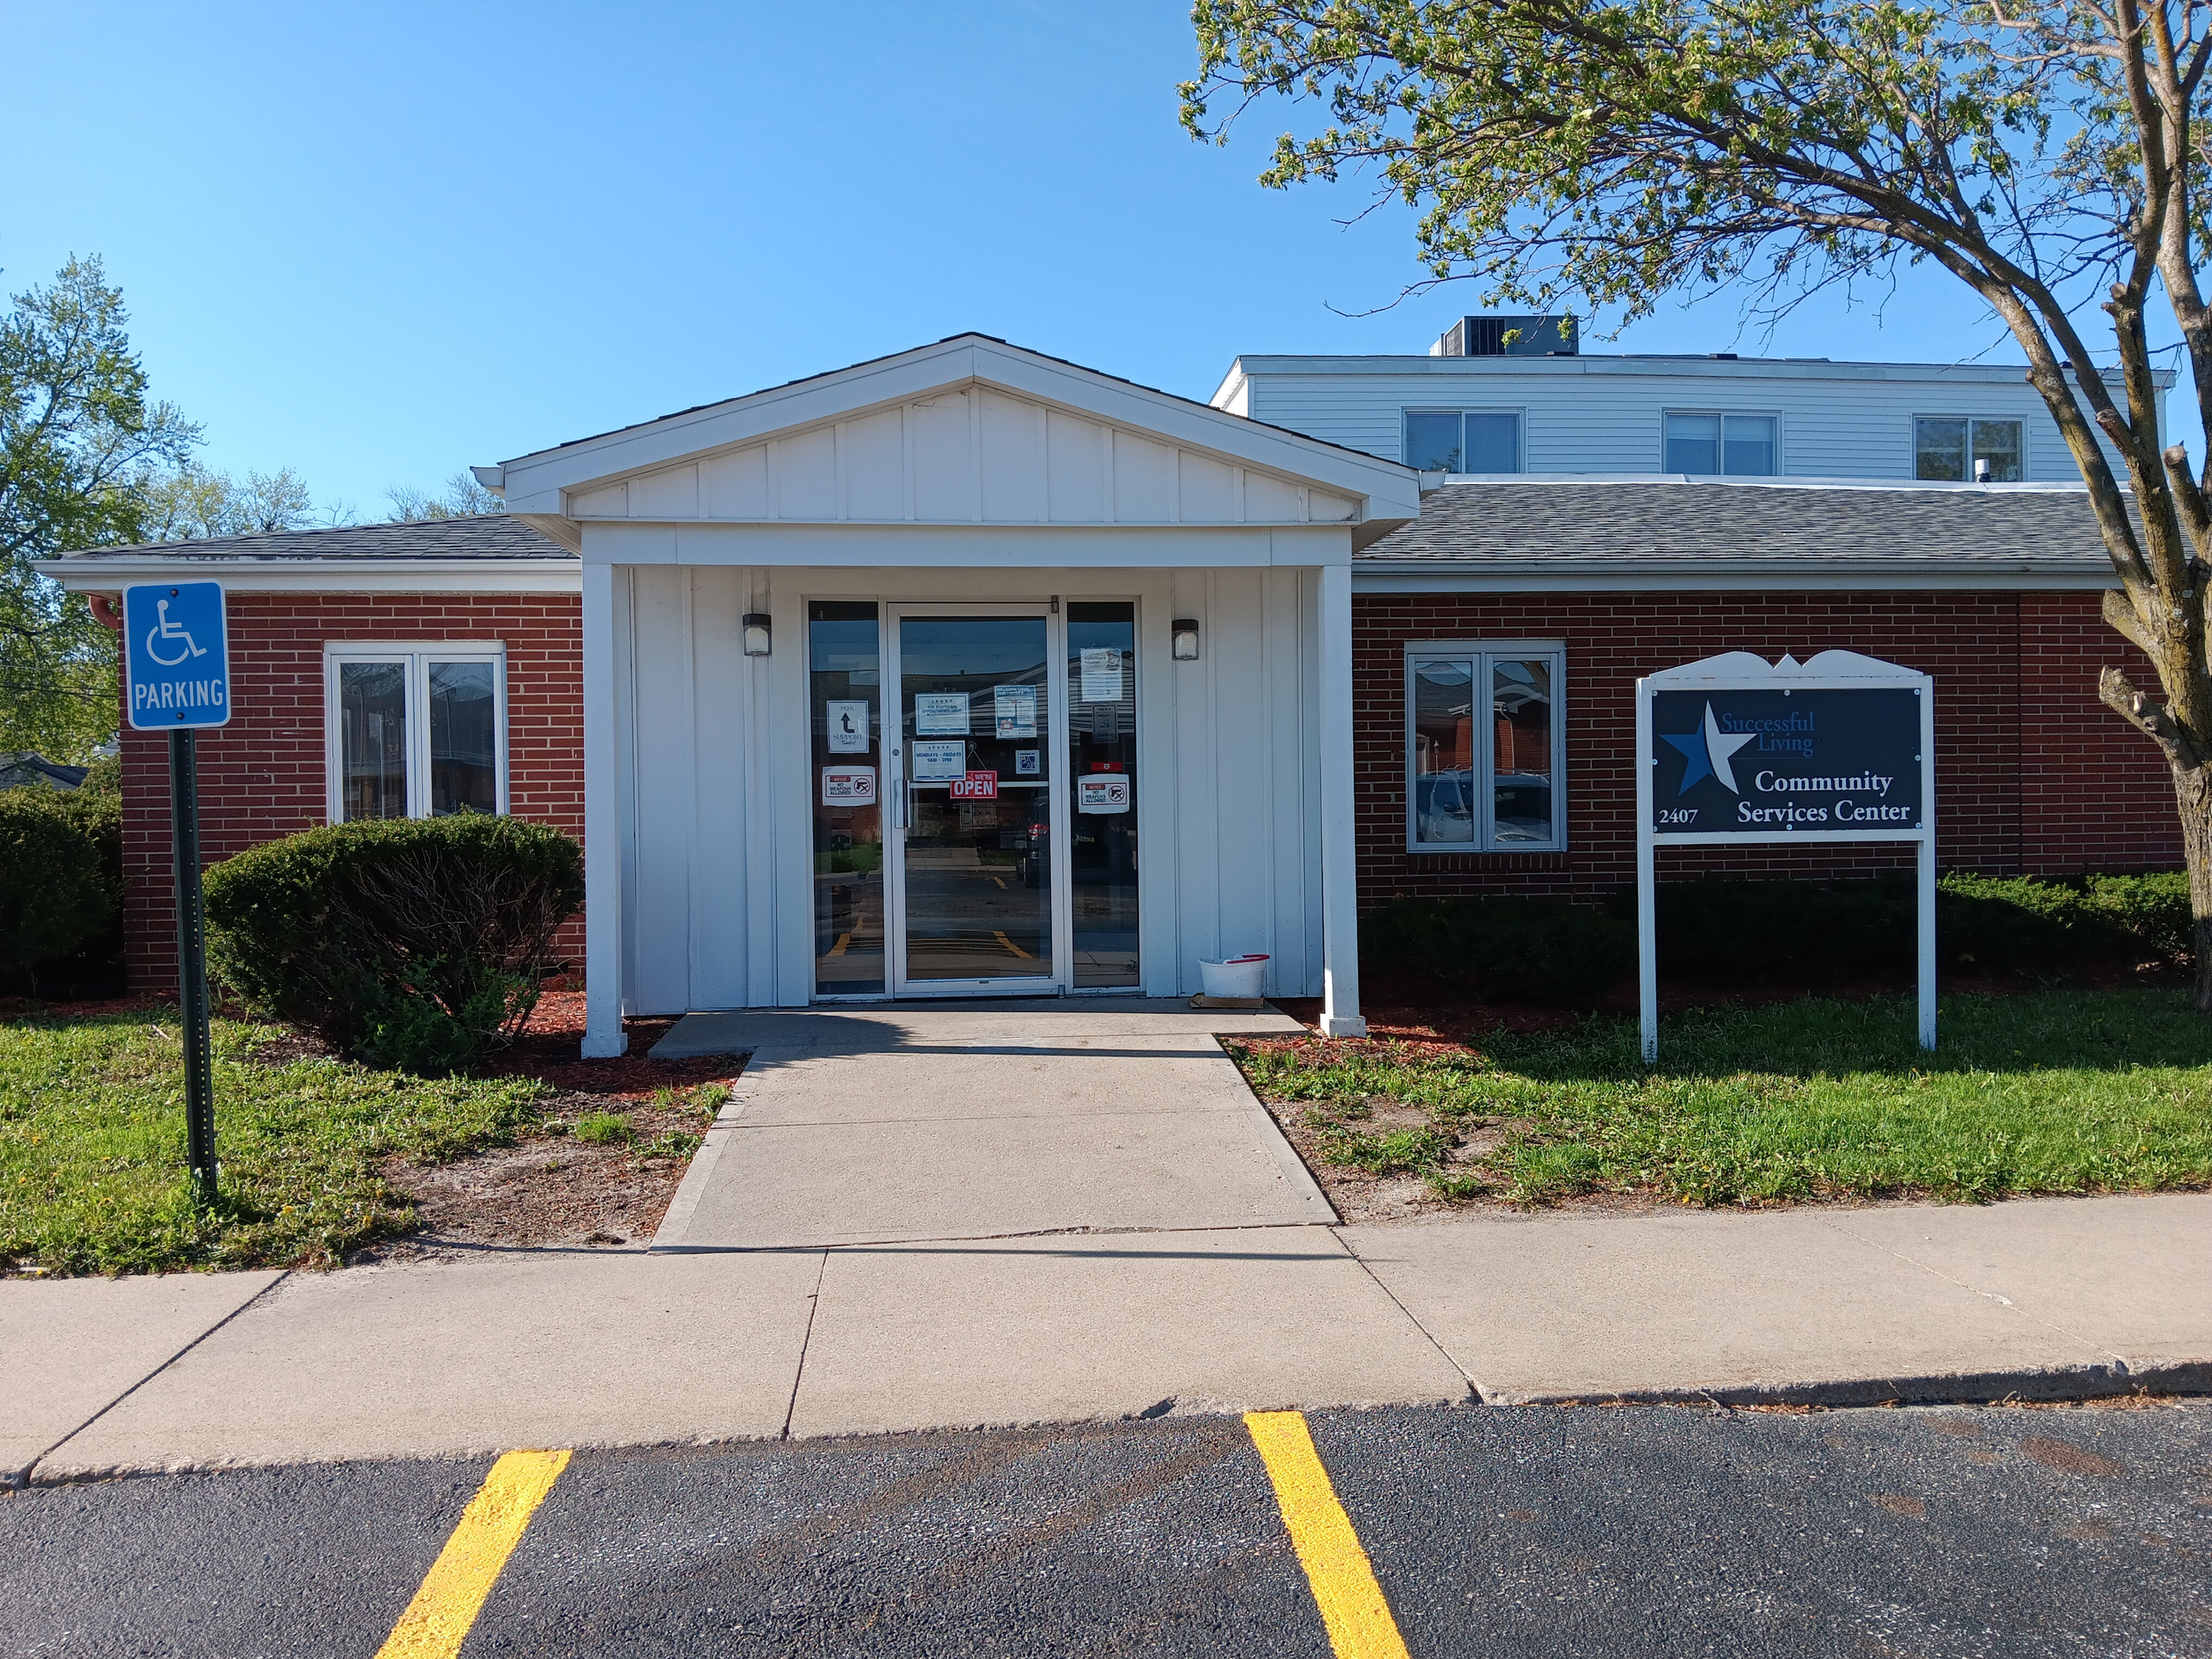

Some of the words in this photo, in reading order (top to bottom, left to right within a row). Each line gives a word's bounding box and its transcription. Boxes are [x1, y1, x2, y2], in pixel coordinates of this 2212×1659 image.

[135, 679, 223, 710] PARKING
[1721, 711, 1814, 733] Successful
[1758, 733, 1814, 757] Living
[954, 780, 993, 795] OPEN
[1755, 771, 1893, 796] Community
[1659, 809, 1699, 824] 2407
[1738, 801, 1828, 823] Services
[1834, 800, 1910, 821] Center
